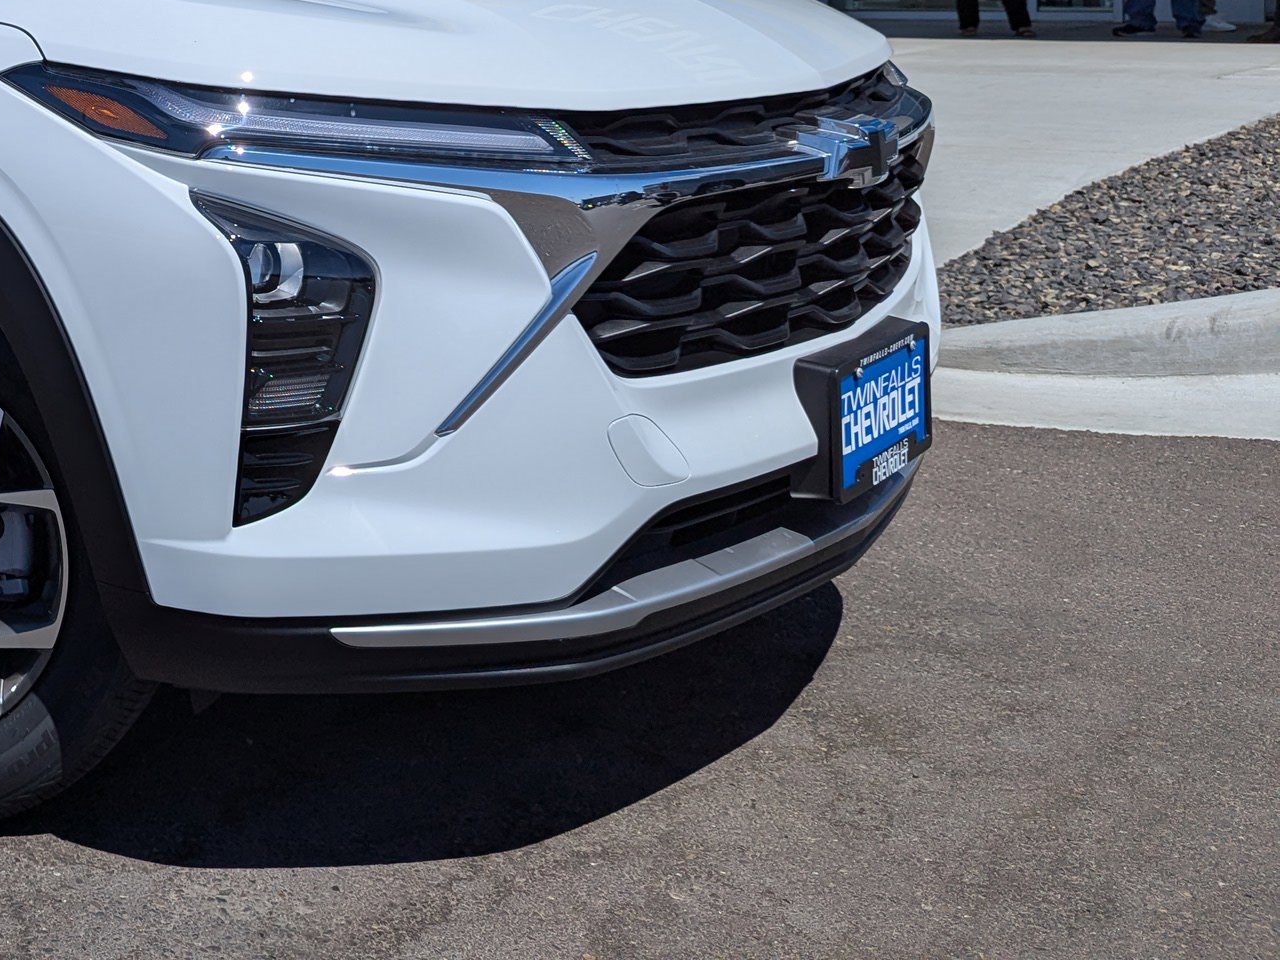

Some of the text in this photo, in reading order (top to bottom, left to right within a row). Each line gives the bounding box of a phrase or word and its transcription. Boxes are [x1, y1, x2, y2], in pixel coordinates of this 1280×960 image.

[841, 355, 921, 416] TWINFALLS
[841, 377, 921, 456] CHEVROLET
[872, 438, 909, 468] TWINFALLS
[872, 447, 909, 486] CHEVROLET
